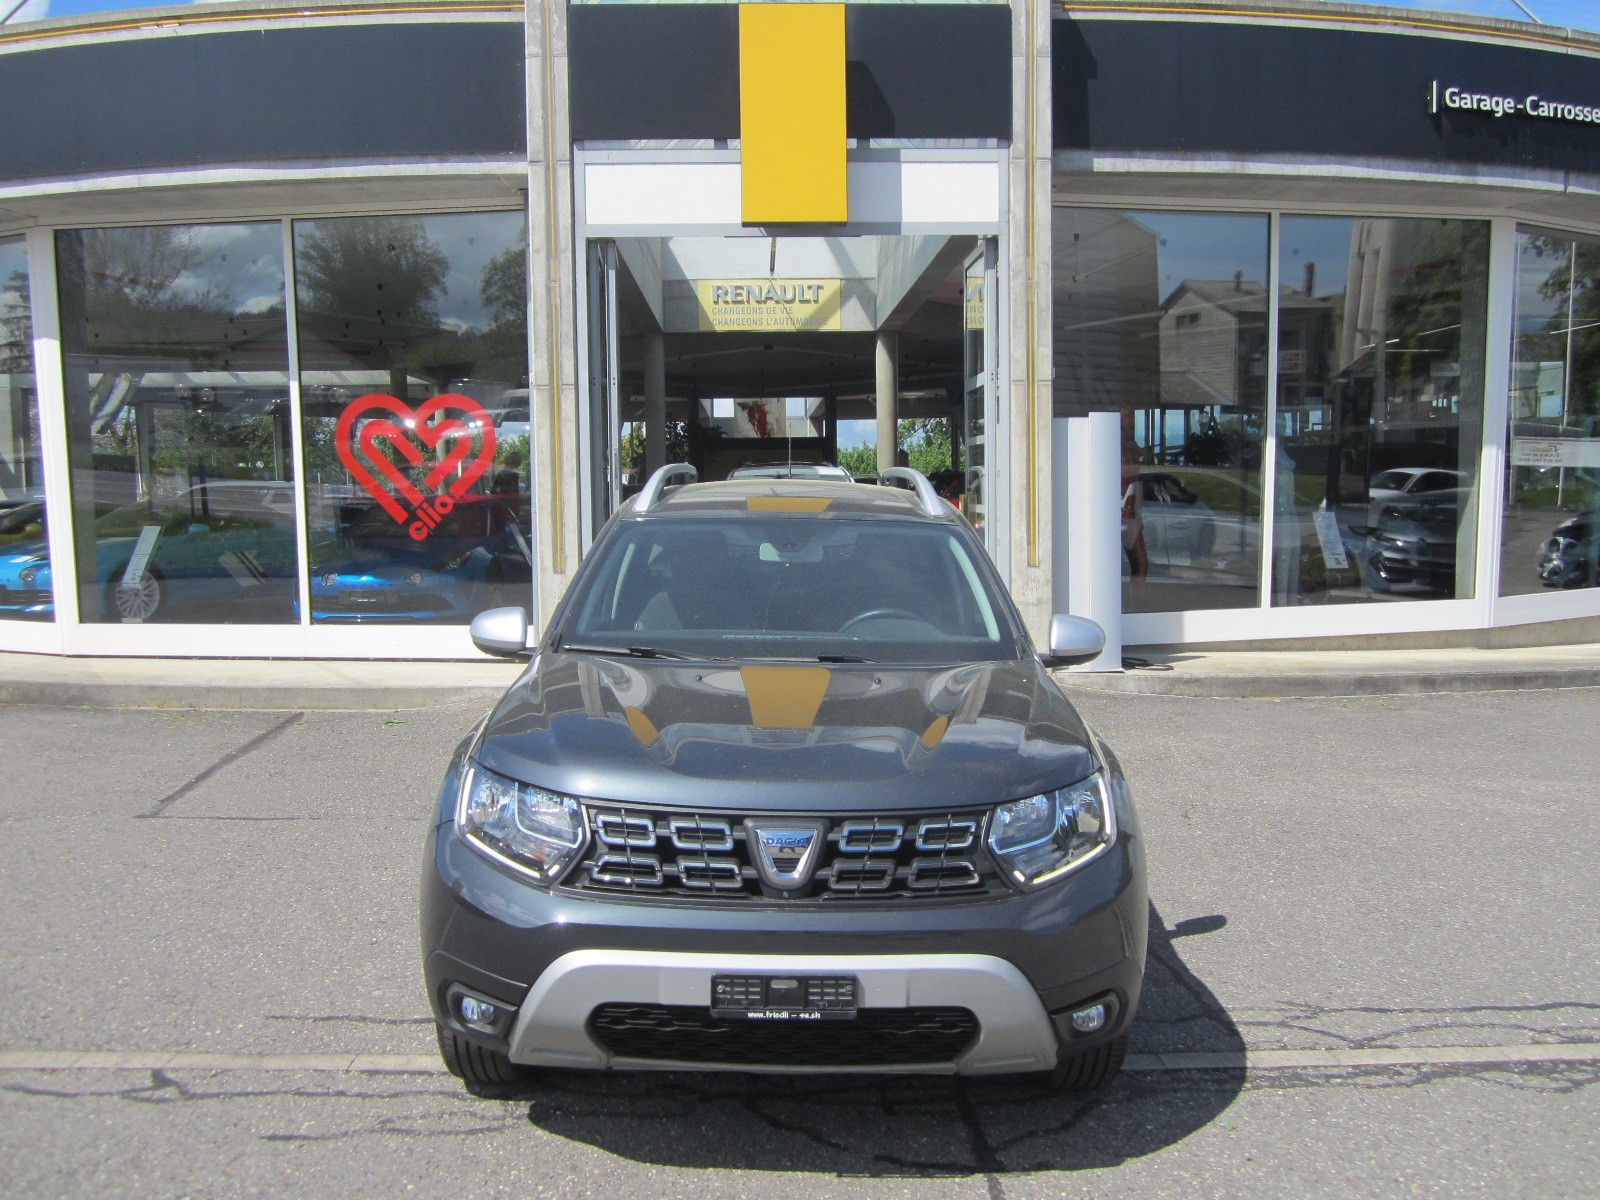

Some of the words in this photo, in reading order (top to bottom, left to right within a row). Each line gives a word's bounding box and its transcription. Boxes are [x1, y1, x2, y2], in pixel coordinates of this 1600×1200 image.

[711, 284, 824, 304] RENAULT
[712, 306, 763, 315] CHANGEONS
[766, 306, 777, 315] DE
[780, 306, 794, 315] VIE
[712, 317, 763, 326] CHANGEONS
[766, 317, 828, 326] L'AUTOMOBILE
[409, 494, 454, 540] clio
[765, 837, 807, 847] DACIA
